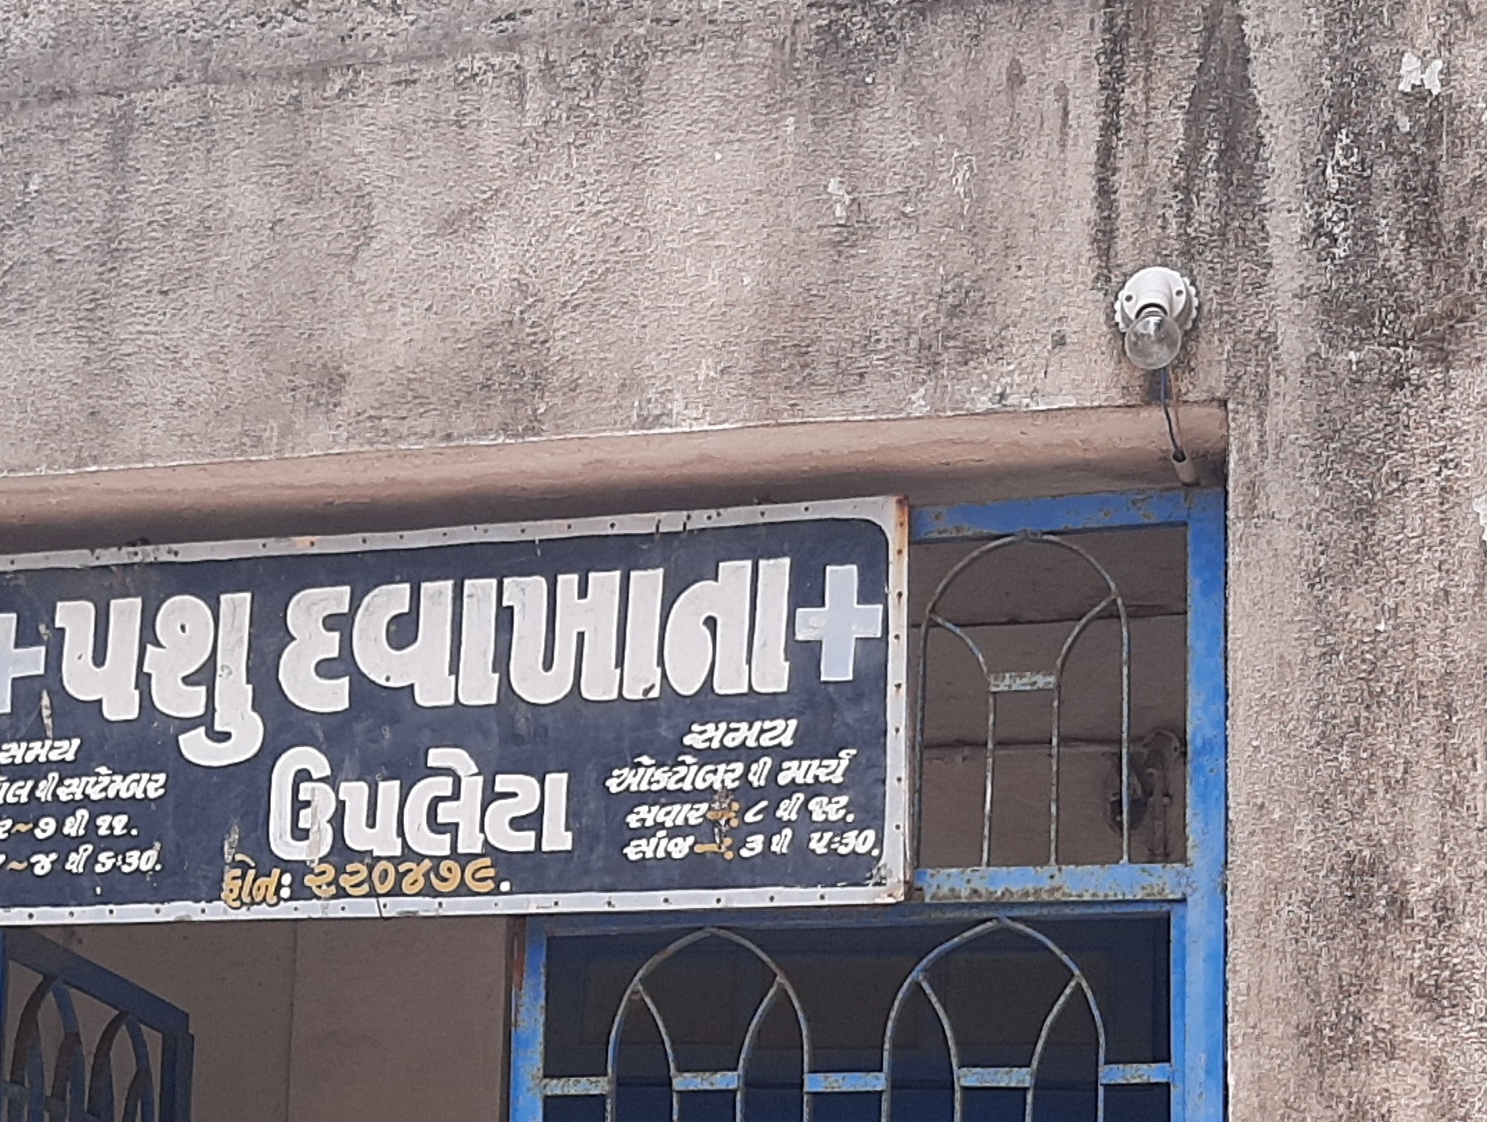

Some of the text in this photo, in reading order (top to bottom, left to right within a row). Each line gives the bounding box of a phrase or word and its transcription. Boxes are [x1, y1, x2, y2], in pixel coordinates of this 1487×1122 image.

[54, 556, 792, 767] પશુ દવાખાના
[682, 718, 798, 749] સમય
[269, 746, 573, 861] ઉપલેટા
